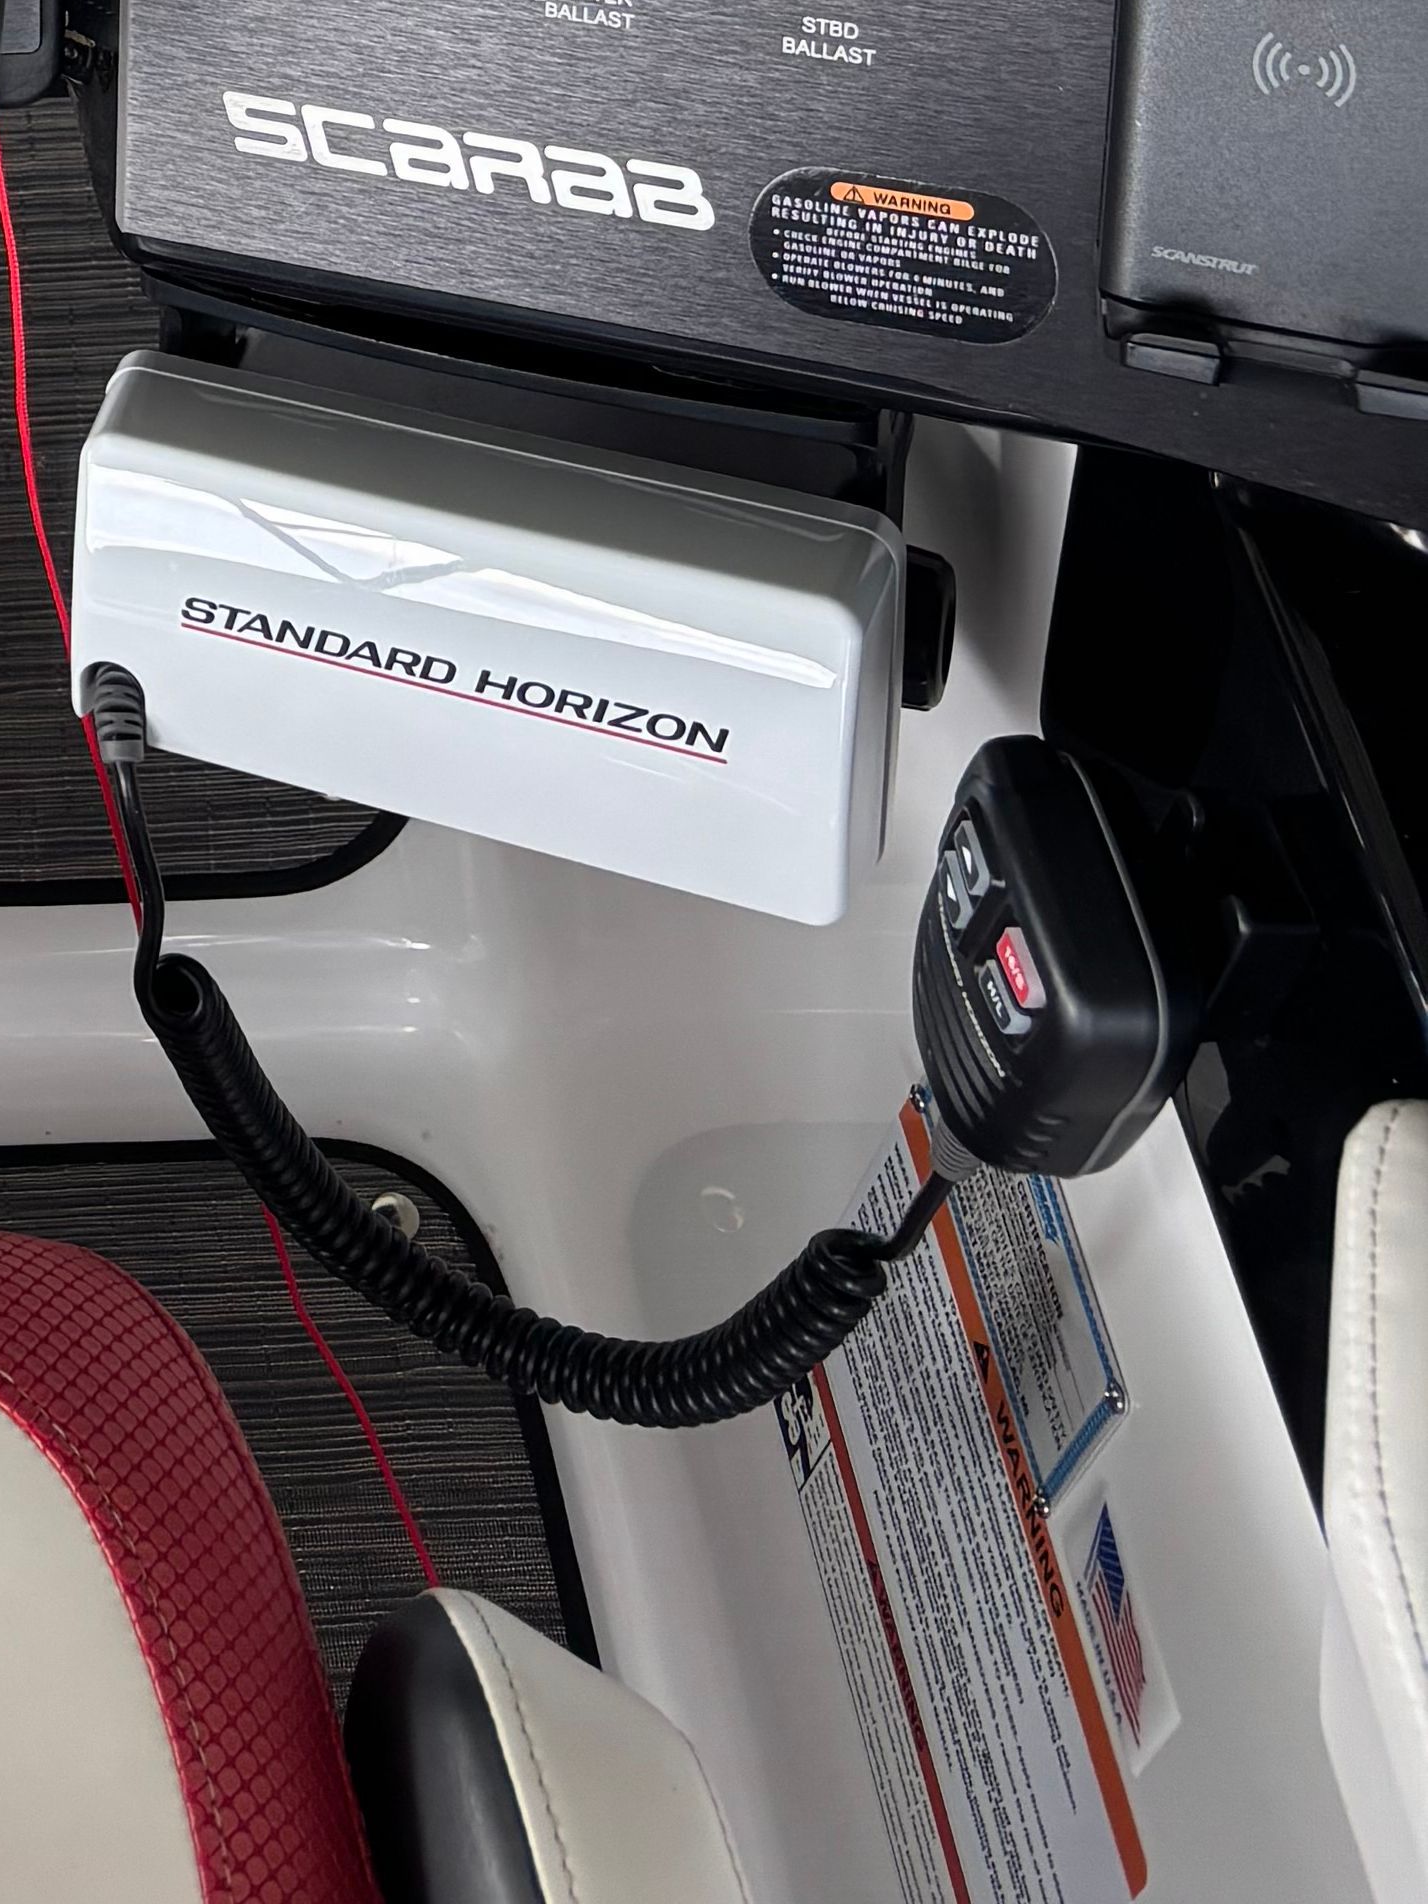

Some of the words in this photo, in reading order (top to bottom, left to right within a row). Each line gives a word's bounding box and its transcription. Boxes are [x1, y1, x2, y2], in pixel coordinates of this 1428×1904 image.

[544, 2, 636, 31] BALLAST
[801, 16, 859, 40] STBD
[781, 37, 877, 67] BALLAST
[772, 194, 850, 217] GASOLINE
[858, 207, 920, 228] VAPORS
[928, 219, 960, 234] CAN
[967, 225, 1039, 248] EXPLODE
[873, 191, 951, 215] WARNING
[771, 206, 858, 230] RESULTING
[865, 221, 883, 234] IN
[890, 225, 949, 244] INJURY
[956, 236, 977, 249] OR
[984, 240, 1037, 260] DEATH
[1151, 245, 1260, 276] SCANSTRUT
[179, 596, 458, 687] STANDARD
[474, 668, 731, 755] HORIZON
[993, 1397, 1066, 1623] WARNING
[877, 1588, 928, 1755] WARNING
